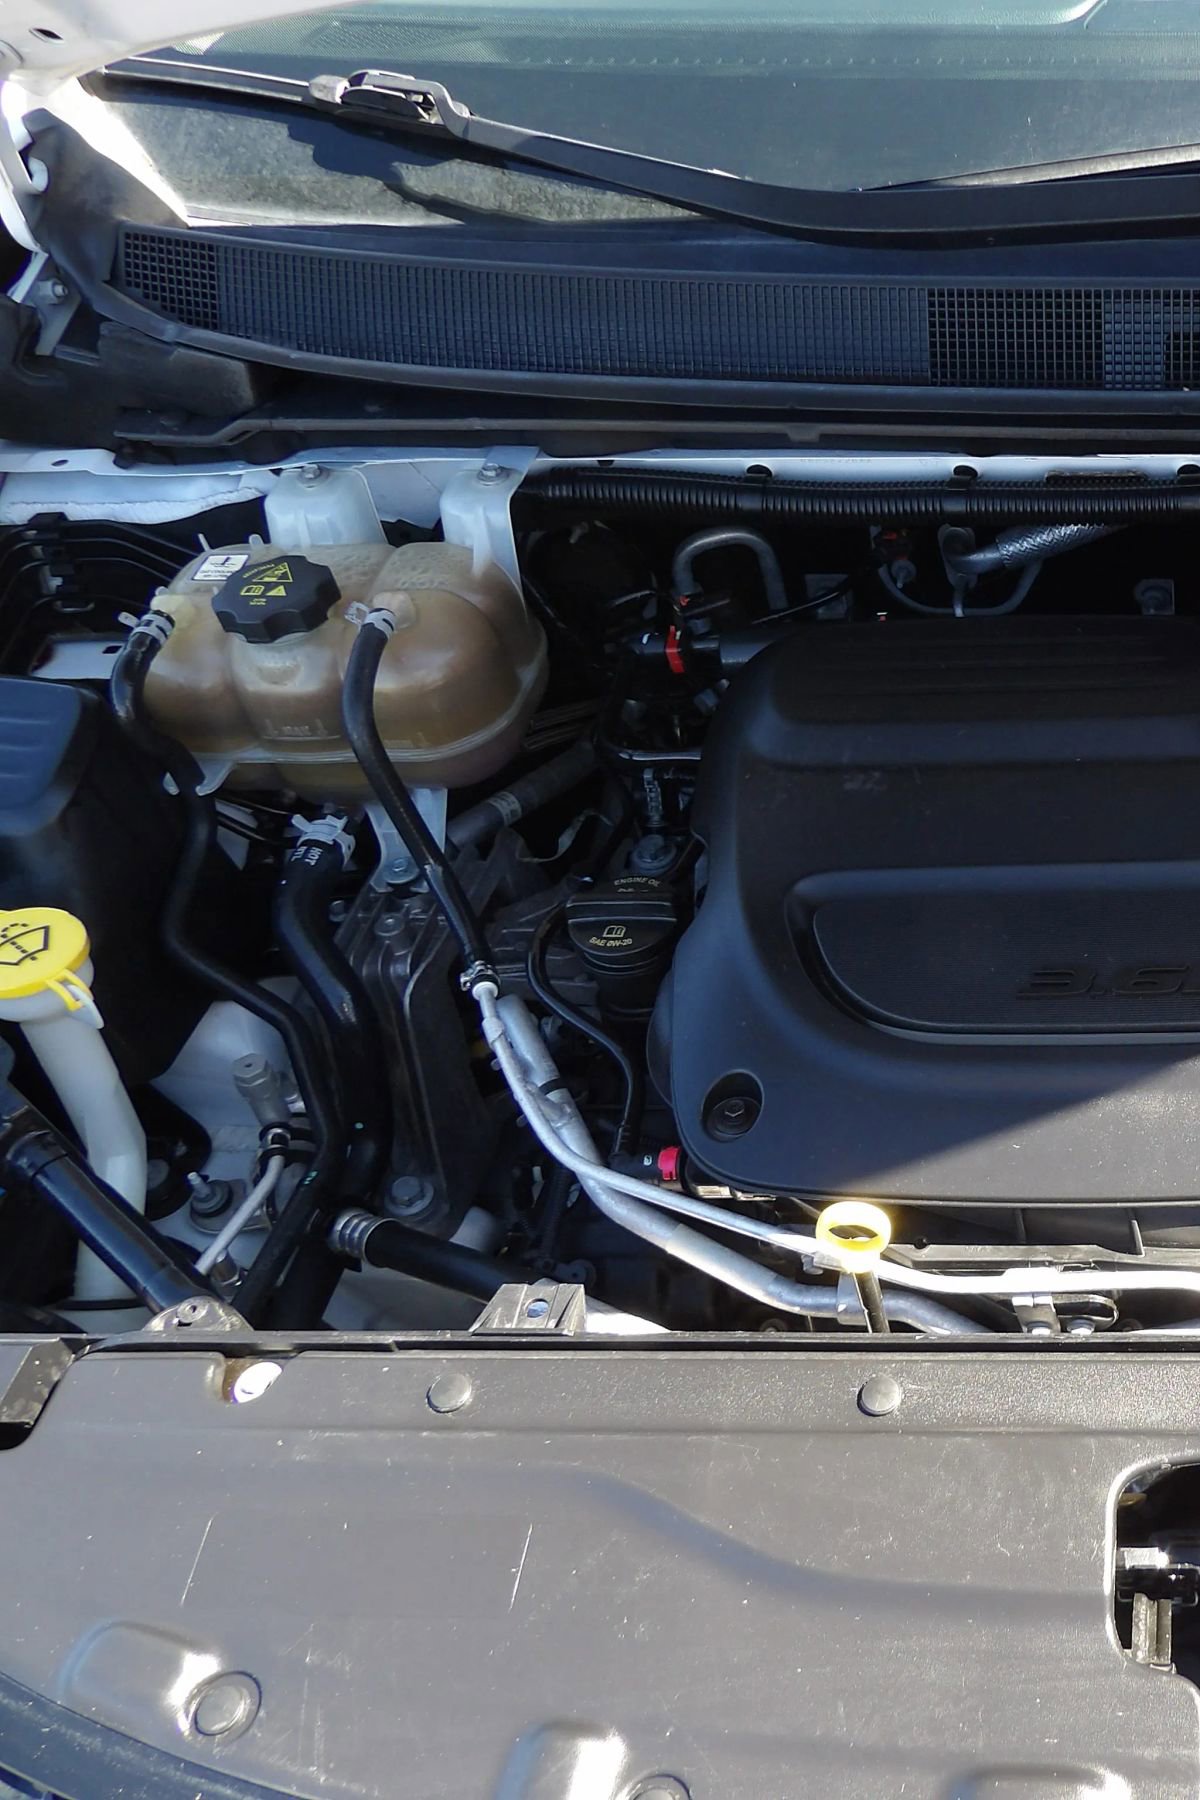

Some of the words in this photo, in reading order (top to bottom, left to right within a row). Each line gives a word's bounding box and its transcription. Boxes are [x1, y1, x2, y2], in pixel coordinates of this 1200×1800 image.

[304, 846, 323, 866] HOT
[613, 876, 648, 887] ENGINE
[589, 936, 606, 947] SAE
